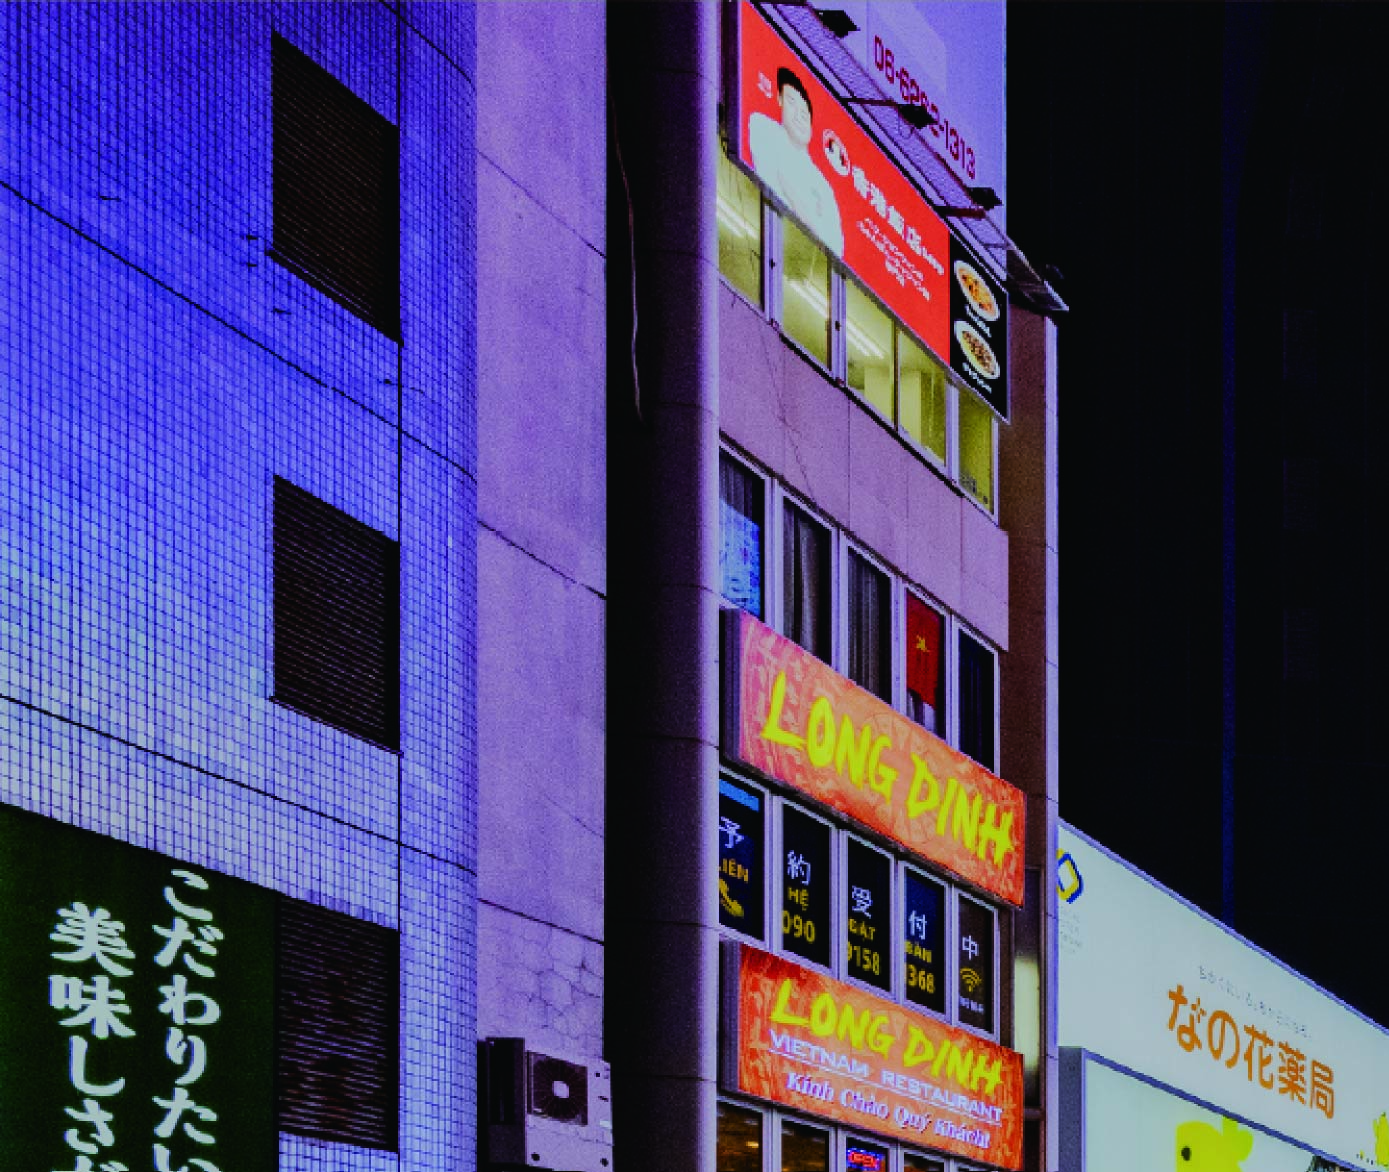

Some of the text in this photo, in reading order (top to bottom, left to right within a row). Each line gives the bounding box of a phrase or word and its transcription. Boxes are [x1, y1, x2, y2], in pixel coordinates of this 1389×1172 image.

[760, 670, 1016, 867] LONG DINH
[768, 1028, 1003, 1124] VIETNAM RESTAURANT
[769, 978, 1003, 1098] LONG DINH
[1166, 984, 1335, 1120] なの花薬局
